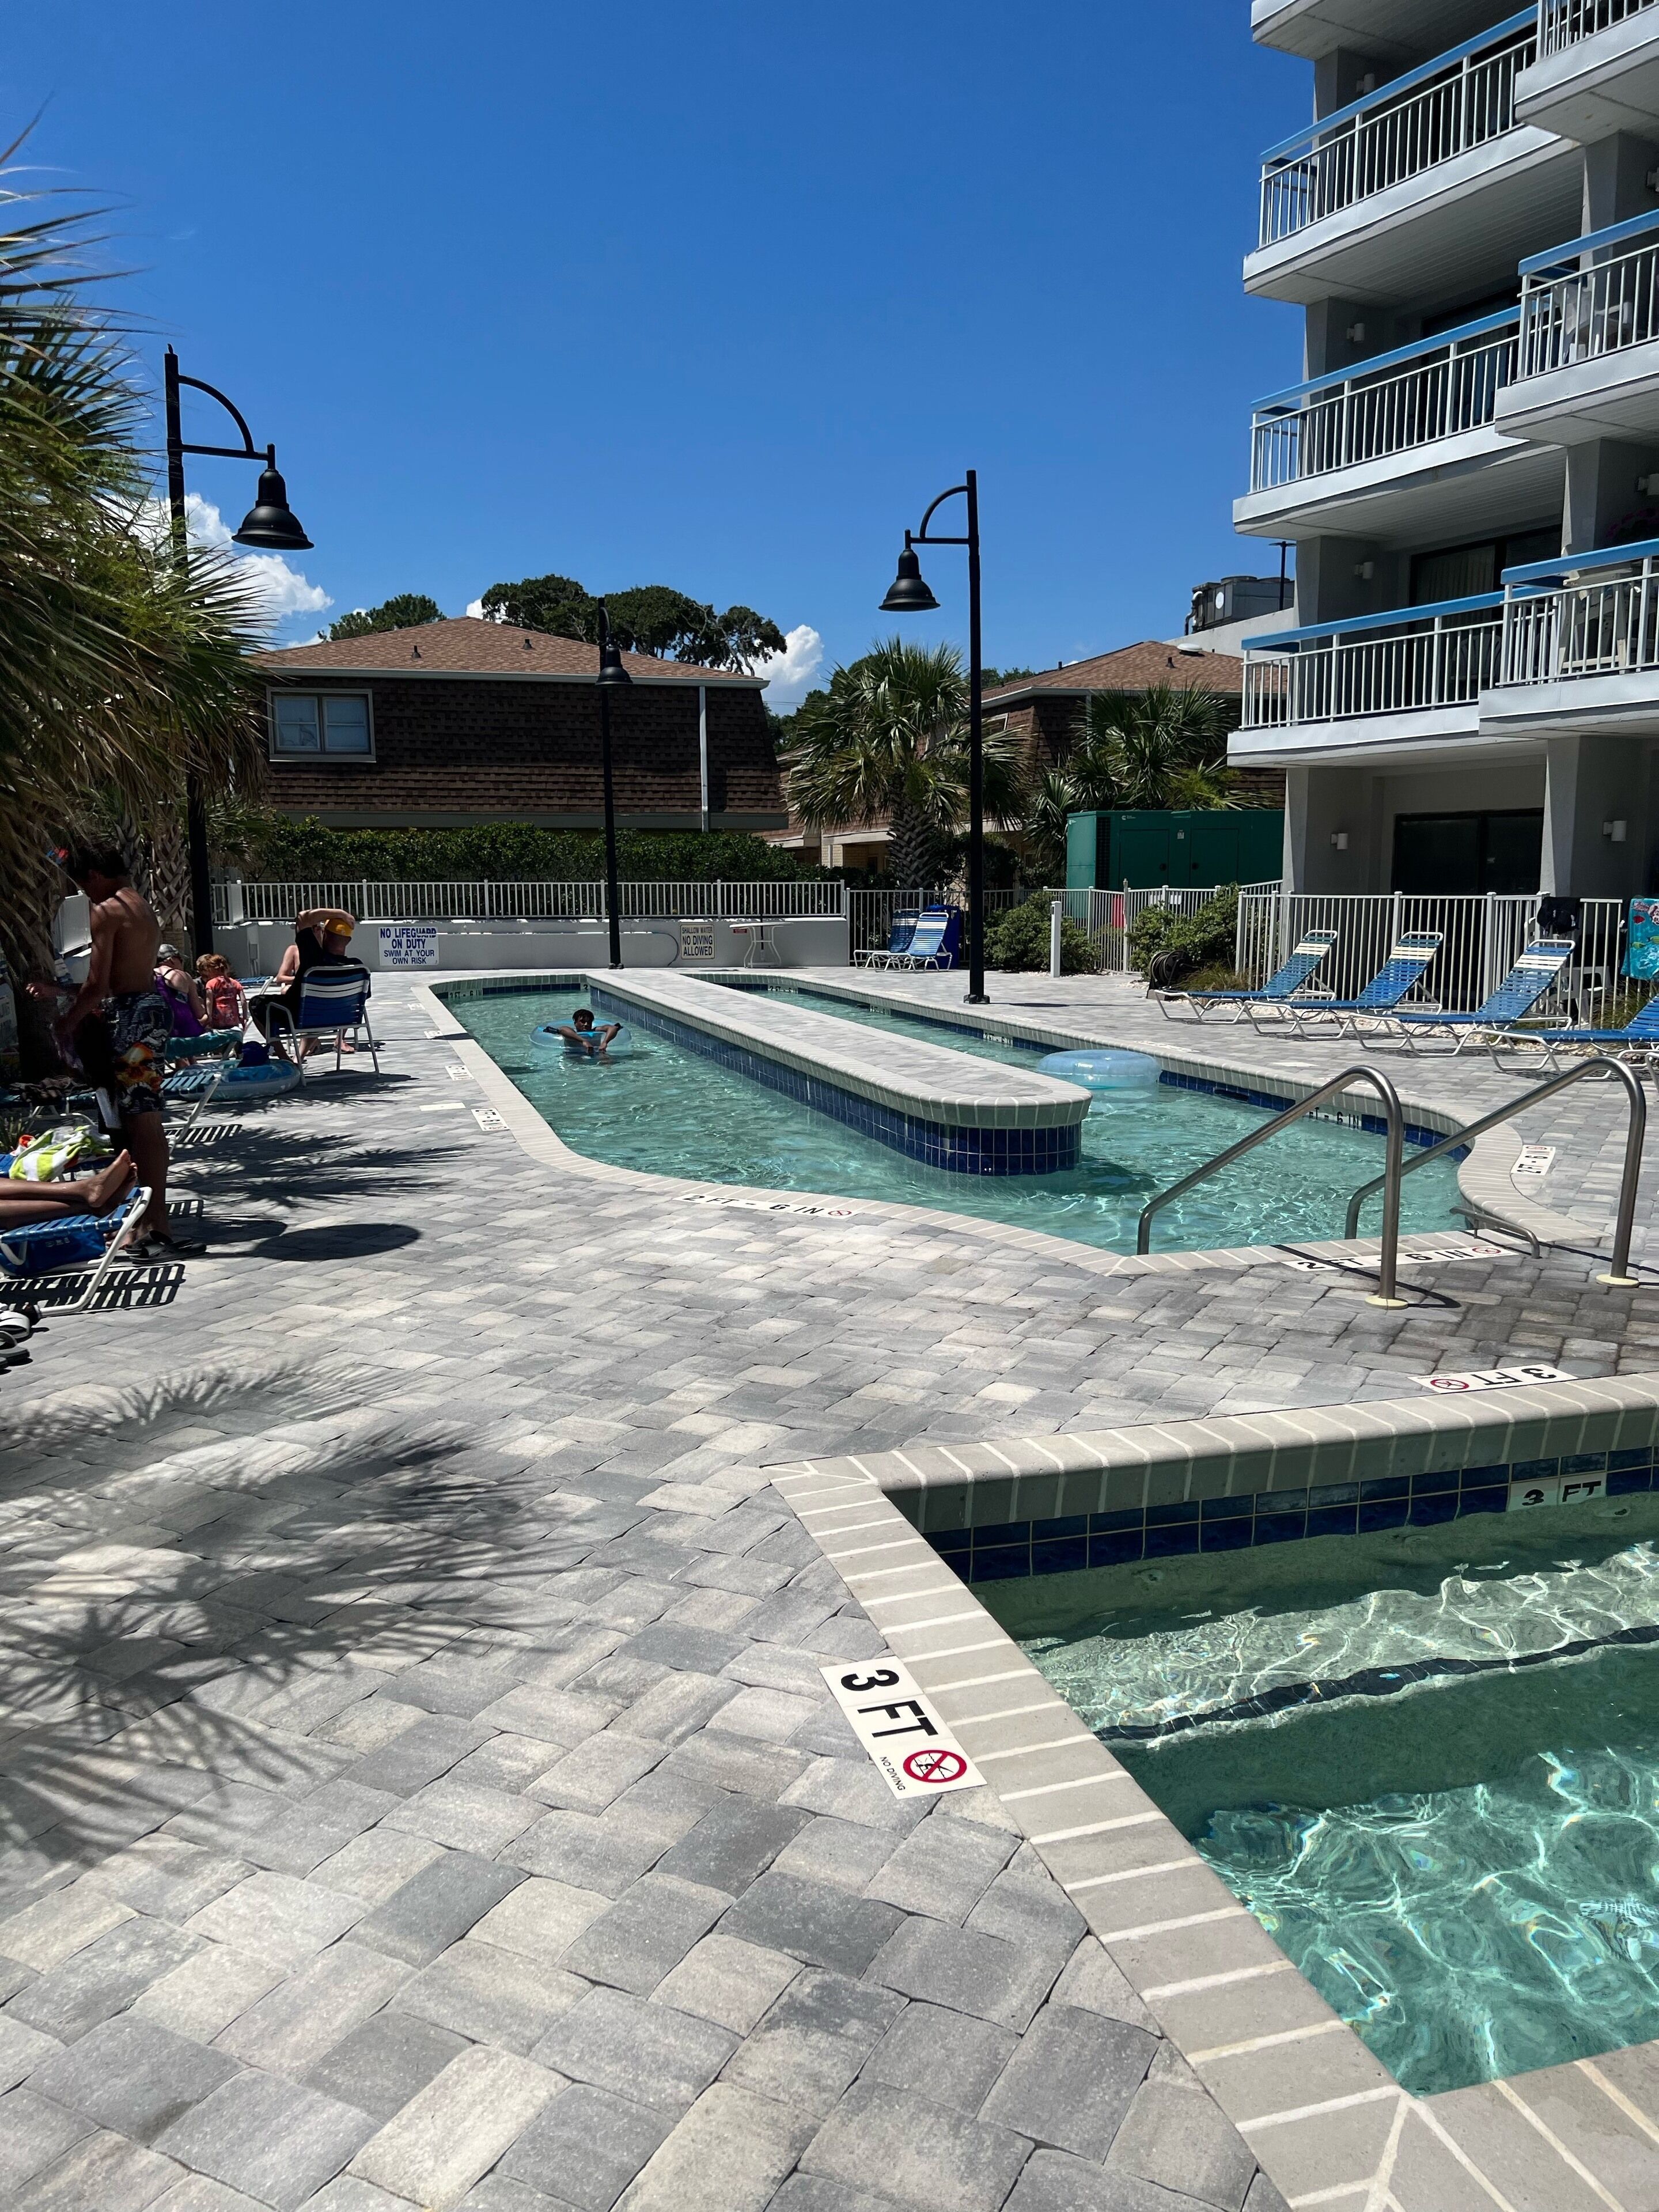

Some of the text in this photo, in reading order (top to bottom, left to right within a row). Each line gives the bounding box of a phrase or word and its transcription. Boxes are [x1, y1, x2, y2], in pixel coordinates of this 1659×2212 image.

[380, 928, 437, 938] NO LIFEGUARD
[682, 935, 713, 945] NO DIVING
[392, 938, 426, 949] ON DUTY
[683, 946, 713, 956] ALLOWED
[1336, 1111, 1343, 1125] 6
[1349, 1113, 1359, 1129] IN
[1434, 1250, 1475, 1259] IN
[1470, 1368, 1557, 1385] 3 FT
[1521, 1480, 1601, 1506] 3 FT
[840, 1669, 939, 1738] 3 FT
[880, 1756, 906, 1791] NO DIVING
